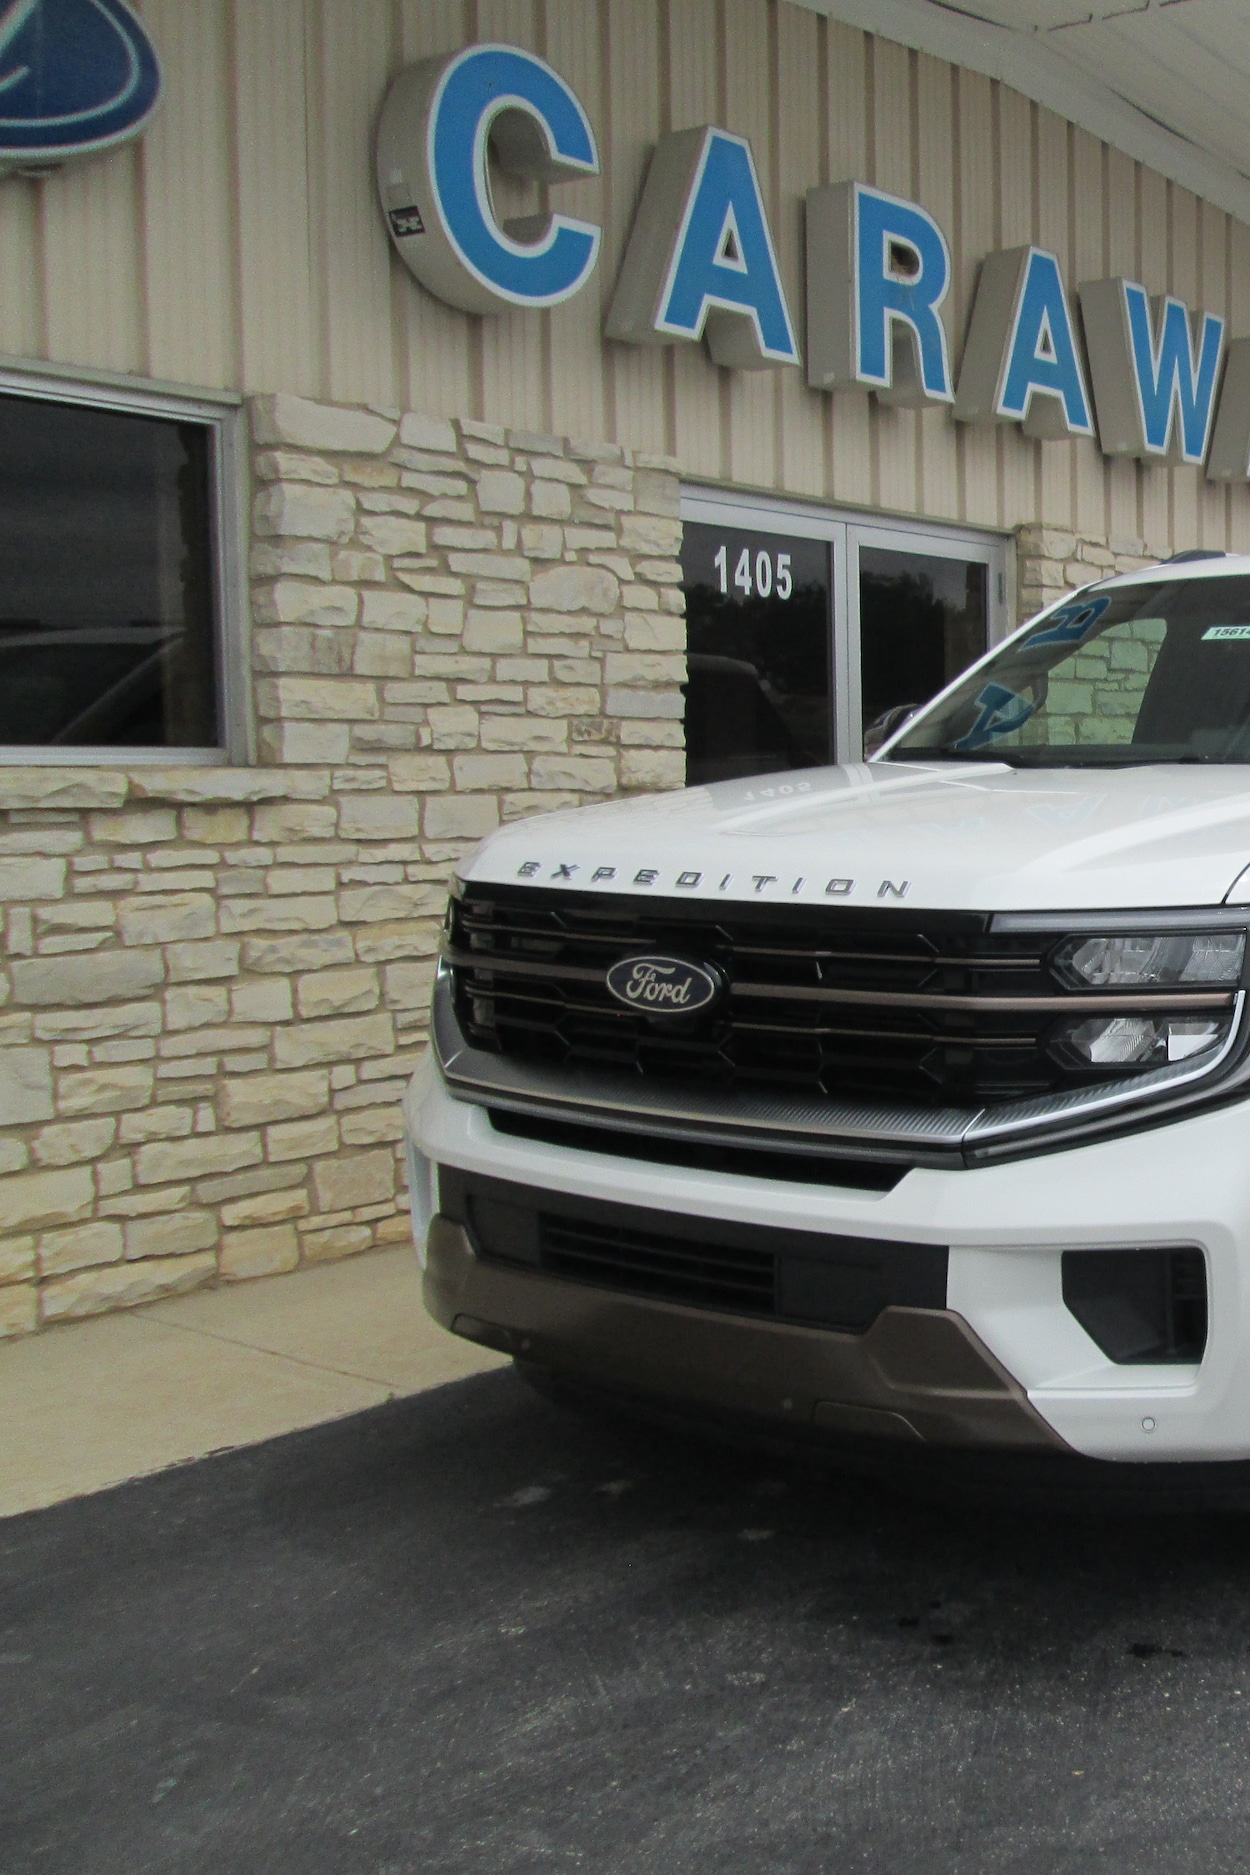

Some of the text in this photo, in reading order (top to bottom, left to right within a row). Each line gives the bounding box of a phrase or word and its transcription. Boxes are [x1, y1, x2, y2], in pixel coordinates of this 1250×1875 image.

[713, 545, 793, 601] 1405
[517, 861, 911, 898] EXPEDITION
[626, 962, 692, 1005] Ford
